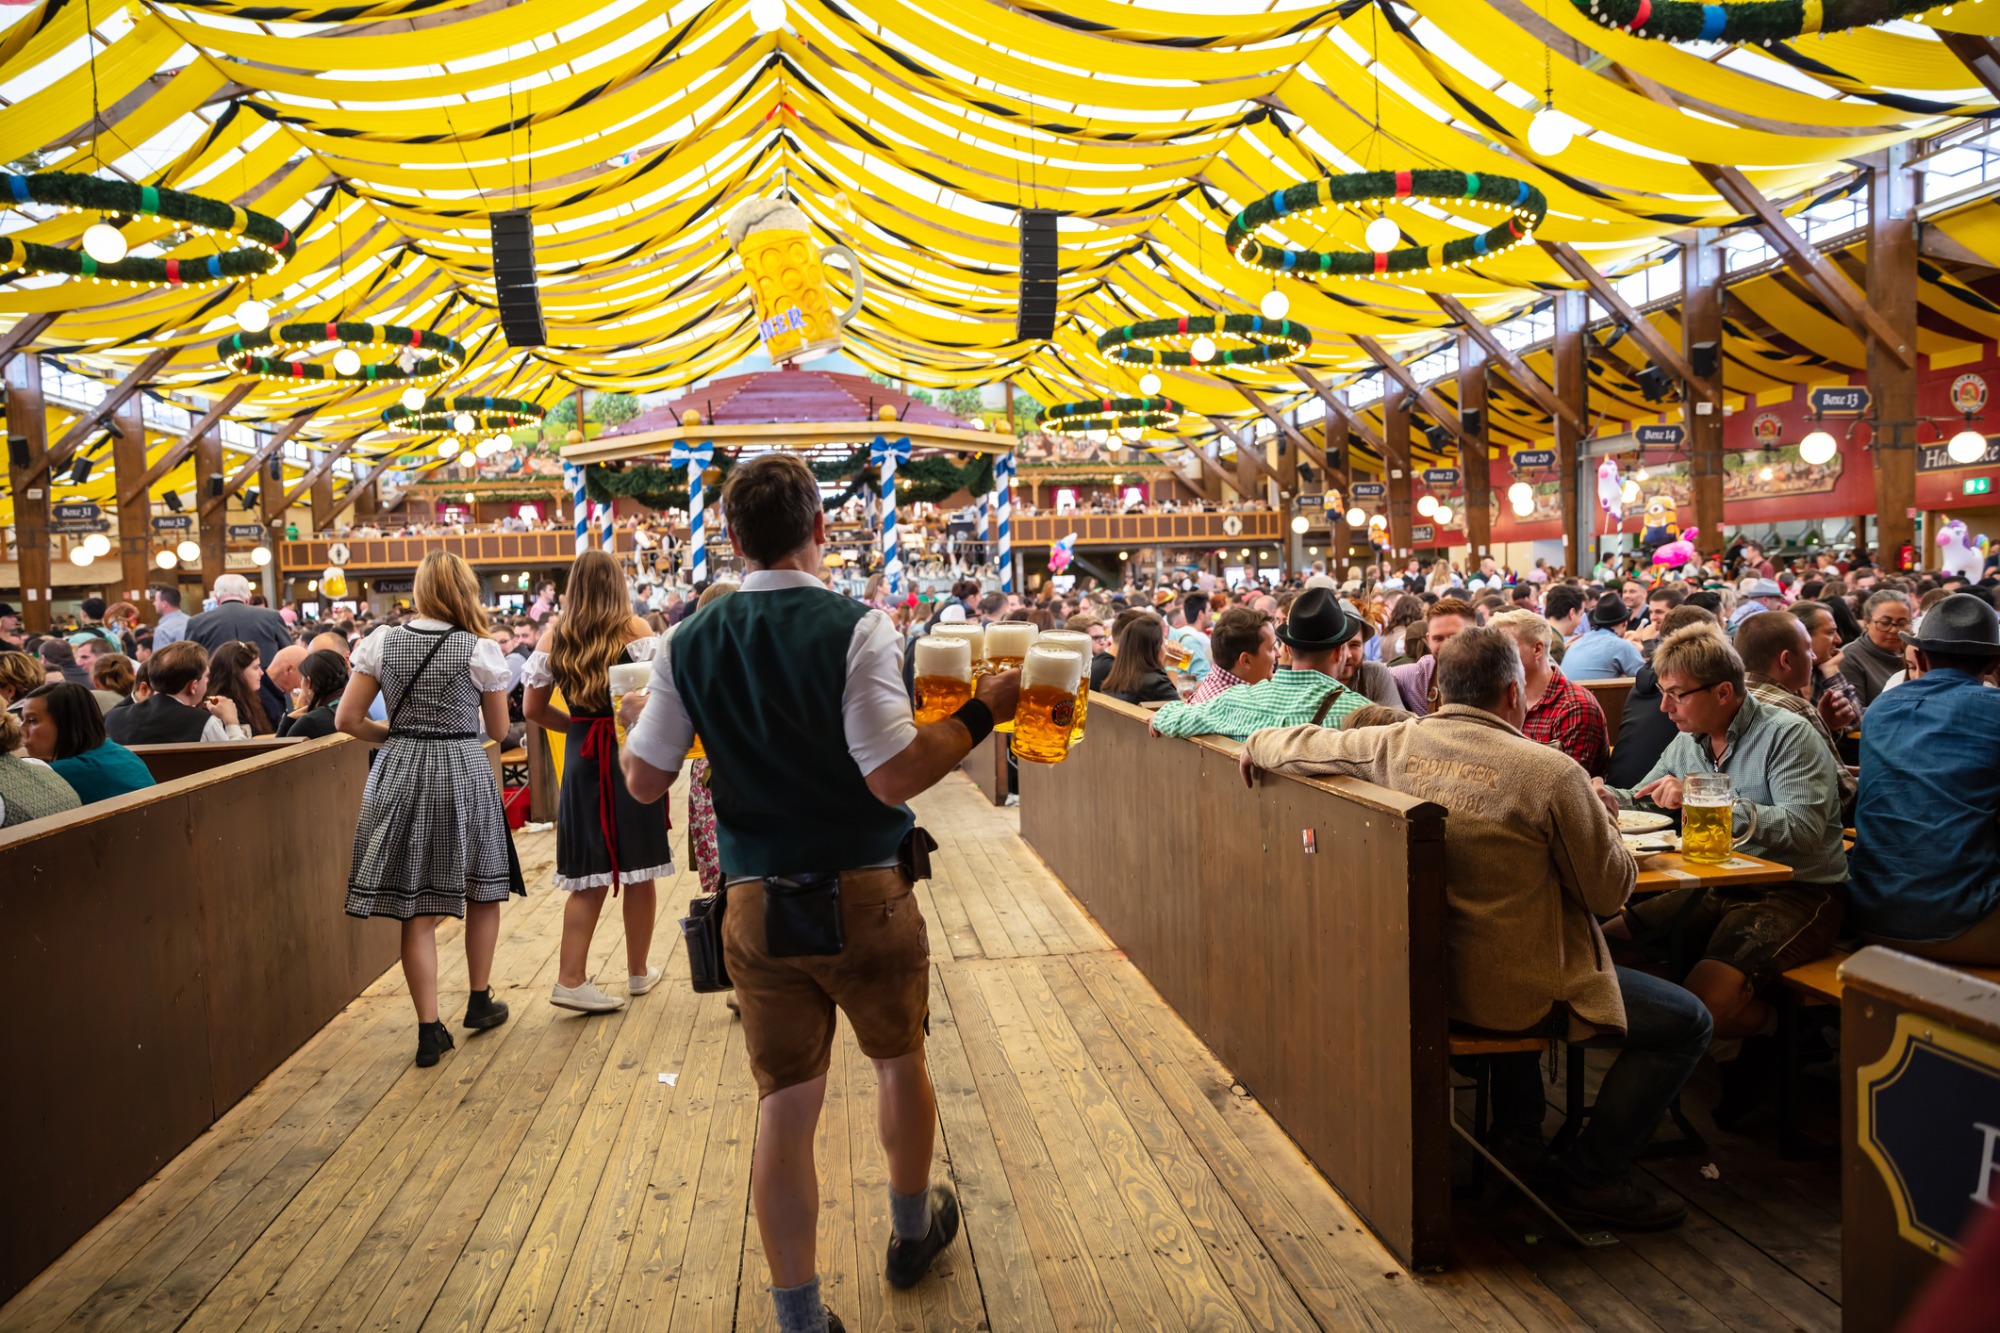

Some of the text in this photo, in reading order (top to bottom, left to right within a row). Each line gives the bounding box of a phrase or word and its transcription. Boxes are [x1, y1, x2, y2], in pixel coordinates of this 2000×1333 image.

[1822, 393, 1859, 408] Boxe 13
[1644, 430, 1676, 442] Boxe 14
[1520, 454, 1549, 463] Boxe 20
[62, 508, 80, 516] Boxe
[1404, 754, 1499, 791] ERDINGER
